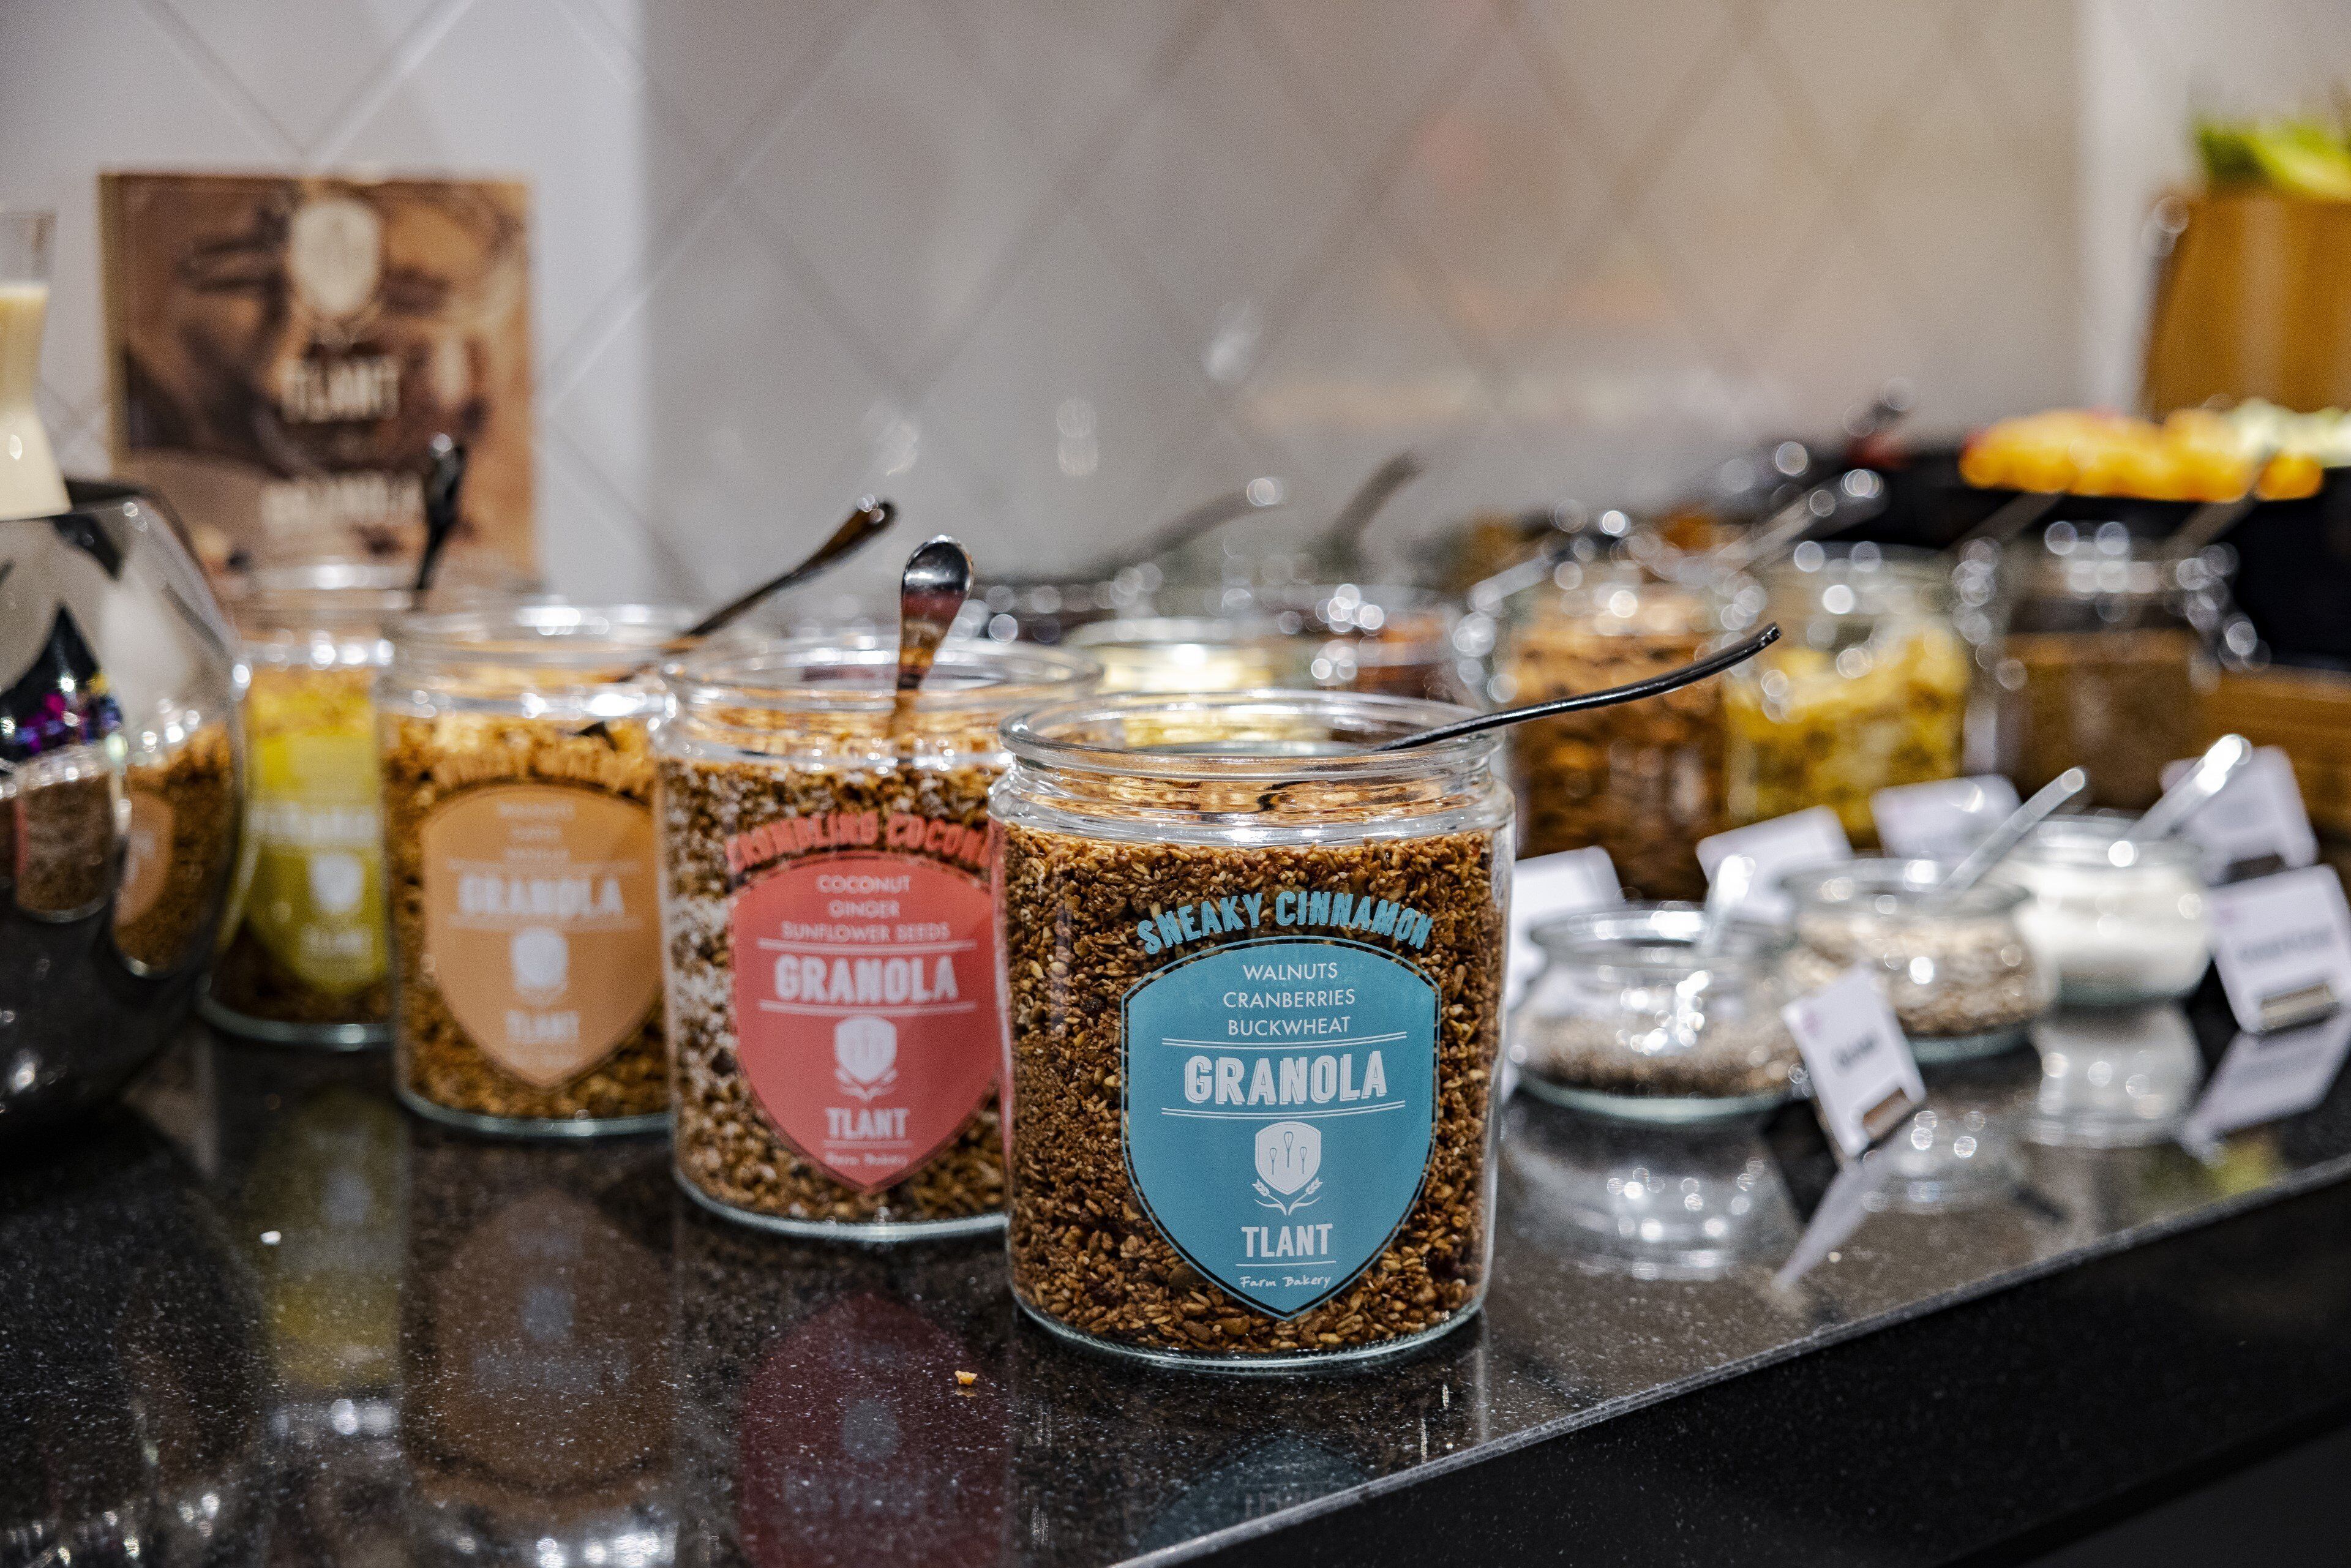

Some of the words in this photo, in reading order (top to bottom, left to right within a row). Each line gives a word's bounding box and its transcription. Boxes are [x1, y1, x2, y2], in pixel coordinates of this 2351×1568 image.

[817, 874, 910, 894] COCONUT
[829, 899, 900, 918] GINGER
[782, 921, 890, 942] SUNFLOWER
[896, 921, 951, 942] SEEDS
[1137, 893, 1262, 955] SNEAKY
[1276, 891, 1433, 949] CINNAMON
[775, 955, 959, 1003] GRANOLA
[1242, 962, 1339, 981] WALNUTS
[1223, 988, 1356, 1009] CRANBERRIES
[1228, 1016, 1352, 1037] BUCKWHEAT
[1183, 1049, 1388, 1105] GRANOLA
[825, 1107, 910, 1139] TLANT
[1241, 1223, 1333, 1257] TLANT
[1240, 1276, 1276, 1288] Farm
[1282, 1275, 1331, 1288] Bakery
